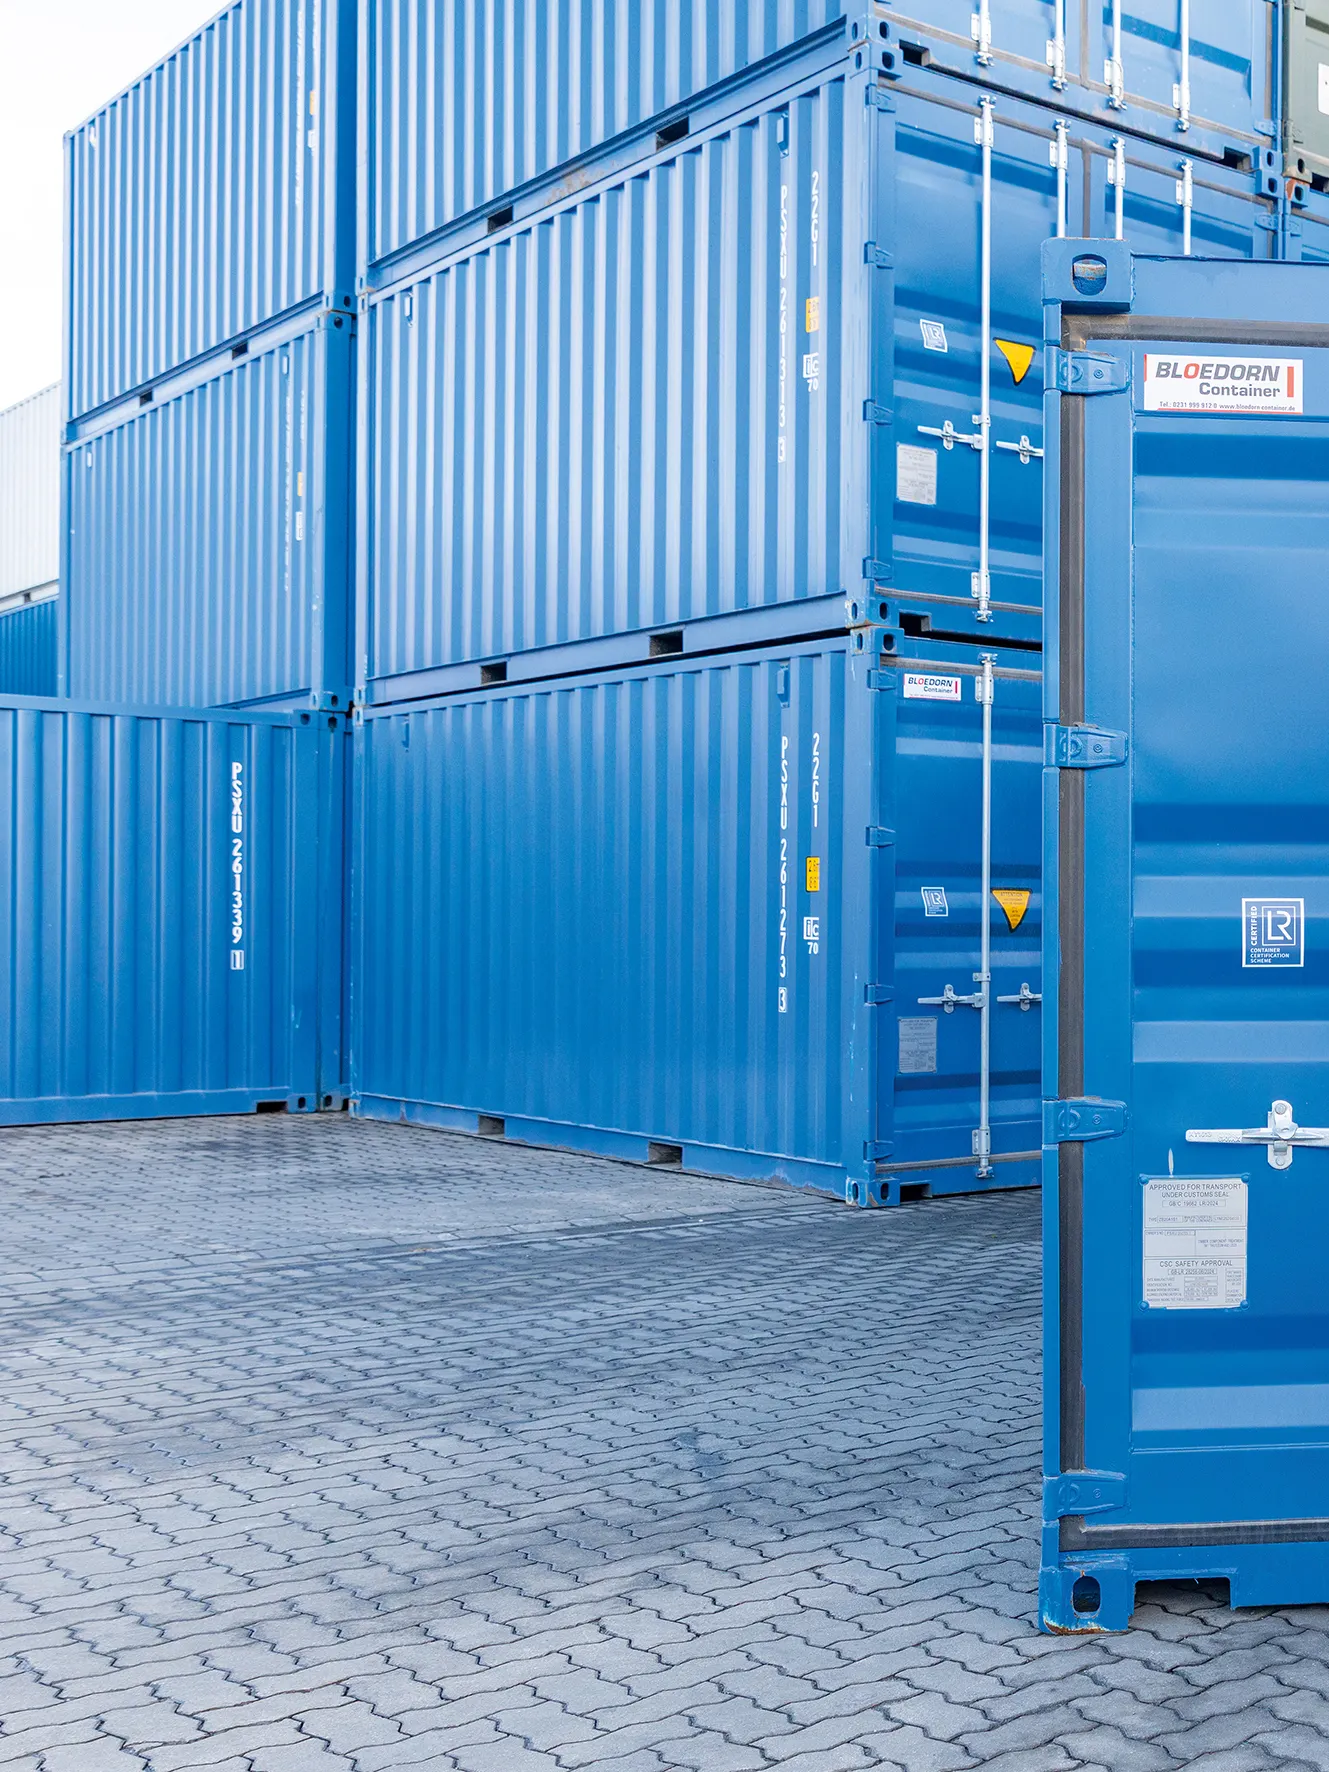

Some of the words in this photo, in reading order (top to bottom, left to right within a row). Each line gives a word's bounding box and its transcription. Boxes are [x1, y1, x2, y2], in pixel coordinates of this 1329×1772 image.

[811, 171, 819, 266] 22G1
[779, 287, 787, 428] 261313
[1155, 362, 1281, 382] BLOEDORN
[1199, 382, 1281, 397] Container
[908, 677, 953, 687] BLOEDORN
[231, 761, 243, 833] PSXU
[812, 732, 820, 828] 22G1
[231, 838, 243, 944] 261339
[779, 838, 787, 978] 261273
[808, 942, 819, 954] 70
[1250, 906, 1258, 946] CERTIFIED
[1149, 1183, 1186, 1191] APPROVED
